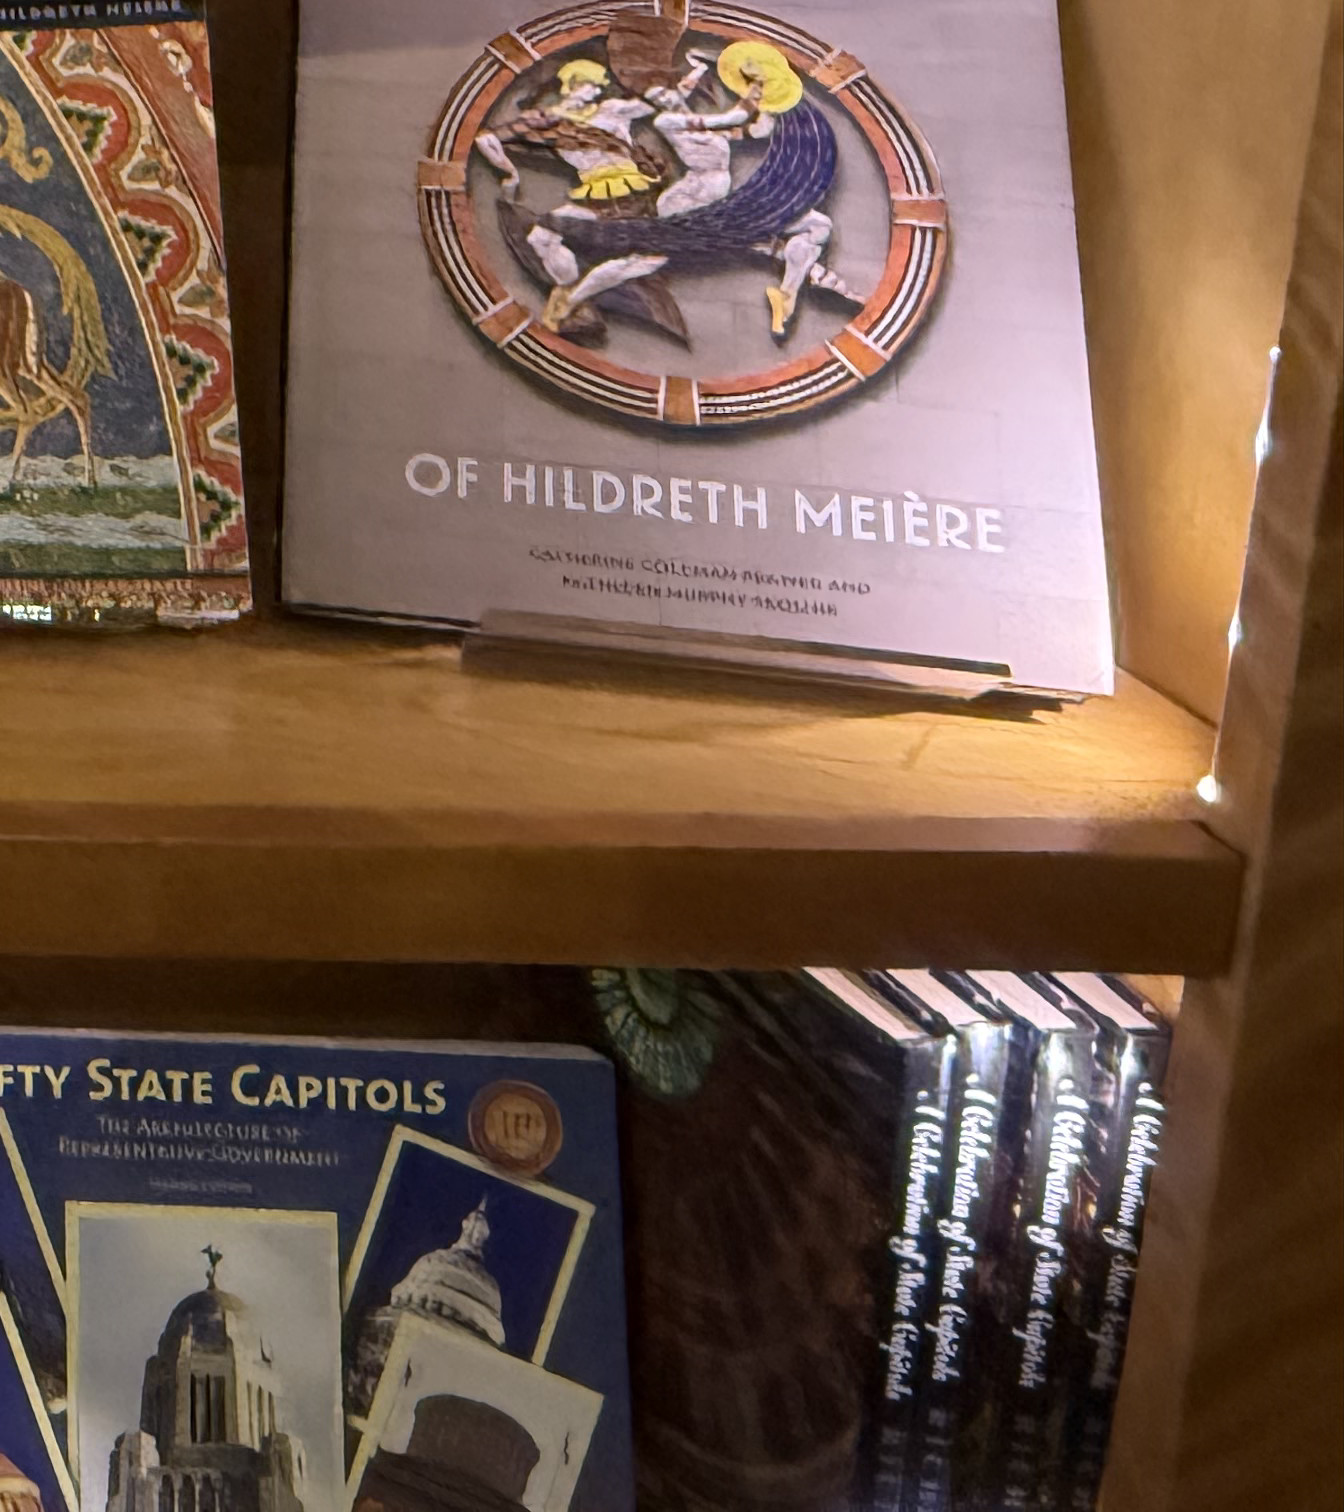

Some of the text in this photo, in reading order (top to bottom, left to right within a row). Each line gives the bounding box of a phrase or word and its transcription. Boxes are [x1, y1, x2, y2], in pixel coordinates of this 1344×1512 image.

[405, 452, 1006, 553] OF HILDRETH MEIÈRE
[87, 1058, 214, 1104] STATE
[230, 1063, 447, 1115] CAPITOLS
